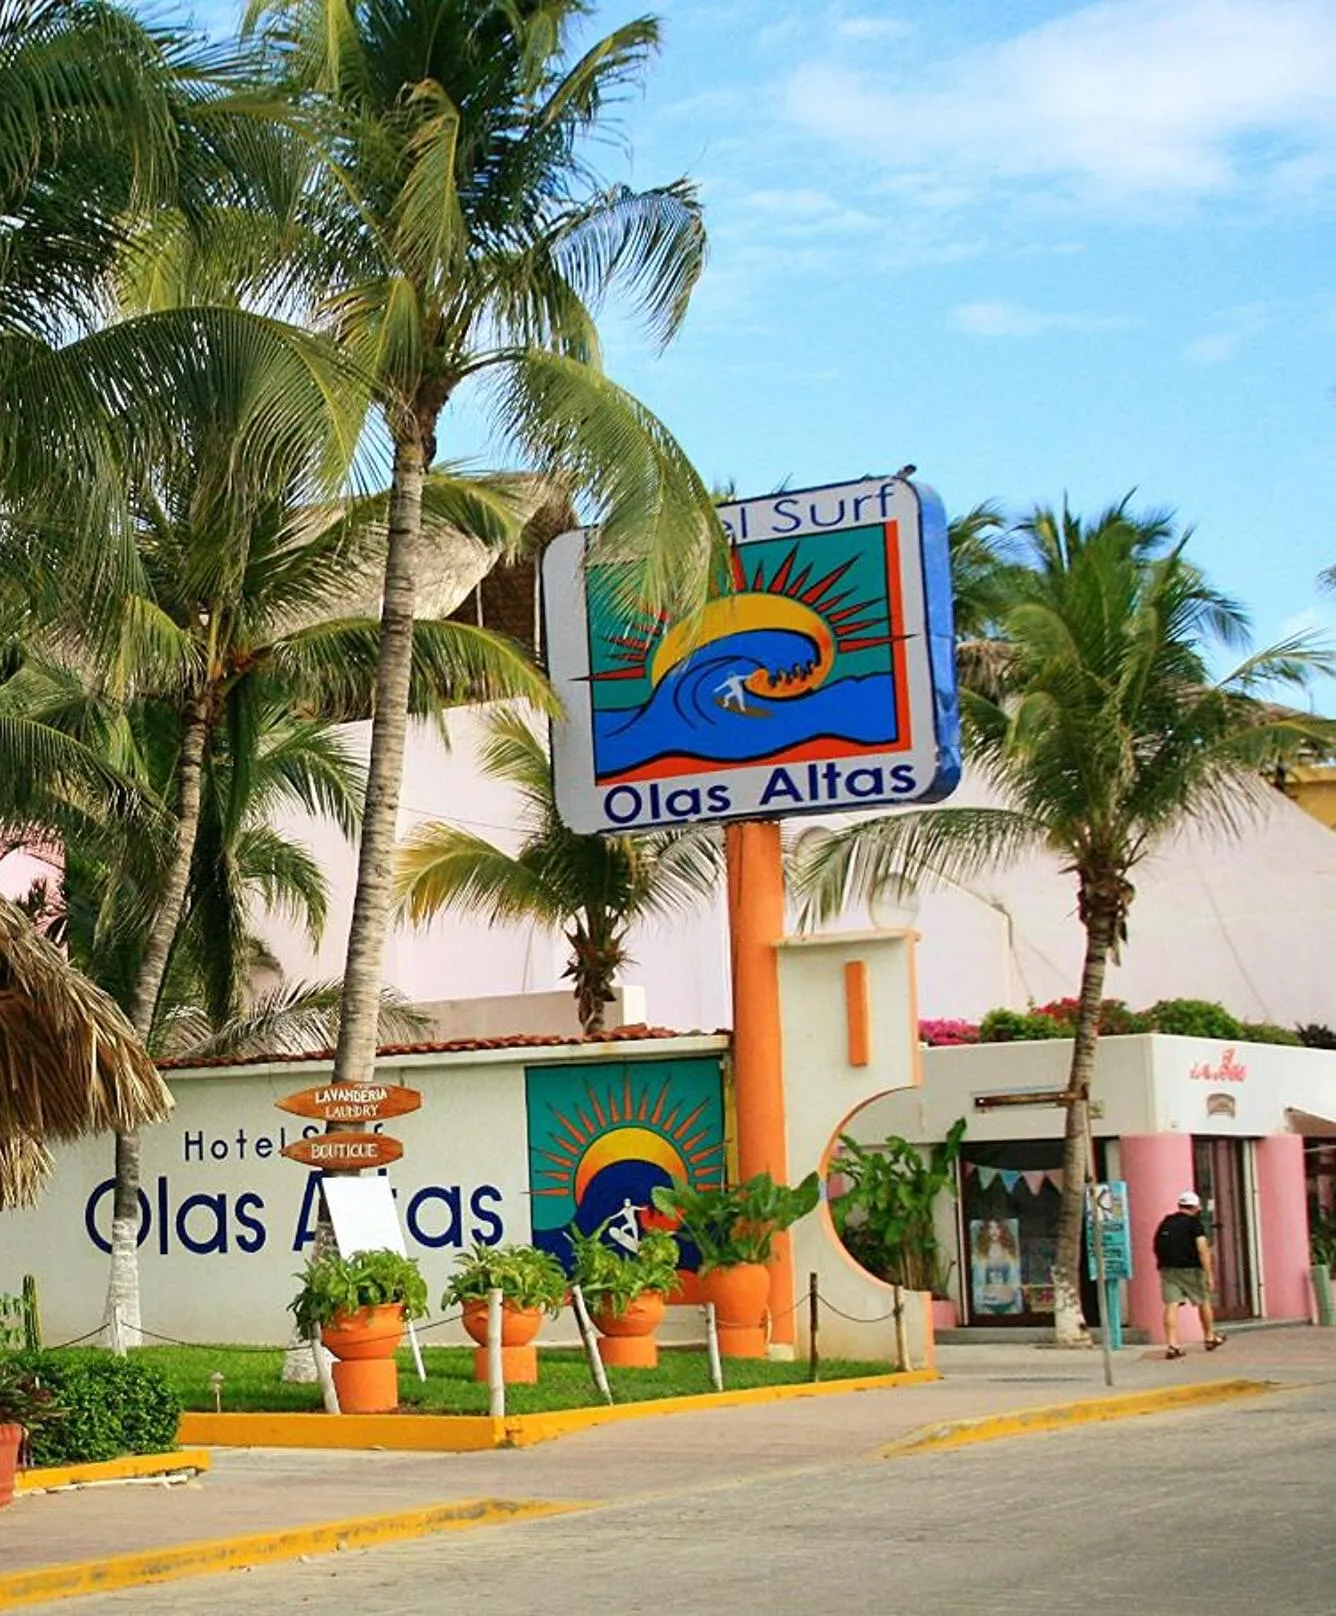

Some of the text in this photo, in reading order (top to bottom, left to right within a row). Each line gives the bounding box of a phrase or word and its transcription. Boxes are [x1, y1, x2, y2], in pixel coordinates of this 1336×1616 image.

[771, 482, 895, 534] Surf
[604, 761, 917, 824] Olas Altas
[314, 1088, 388, 1104] LAVANDERIA
[325, 1104, 379, 1118] LAUNDRY
[184, 1127, 286, 1161] Hotel
[85, 1176, 267, 1255] Olas
